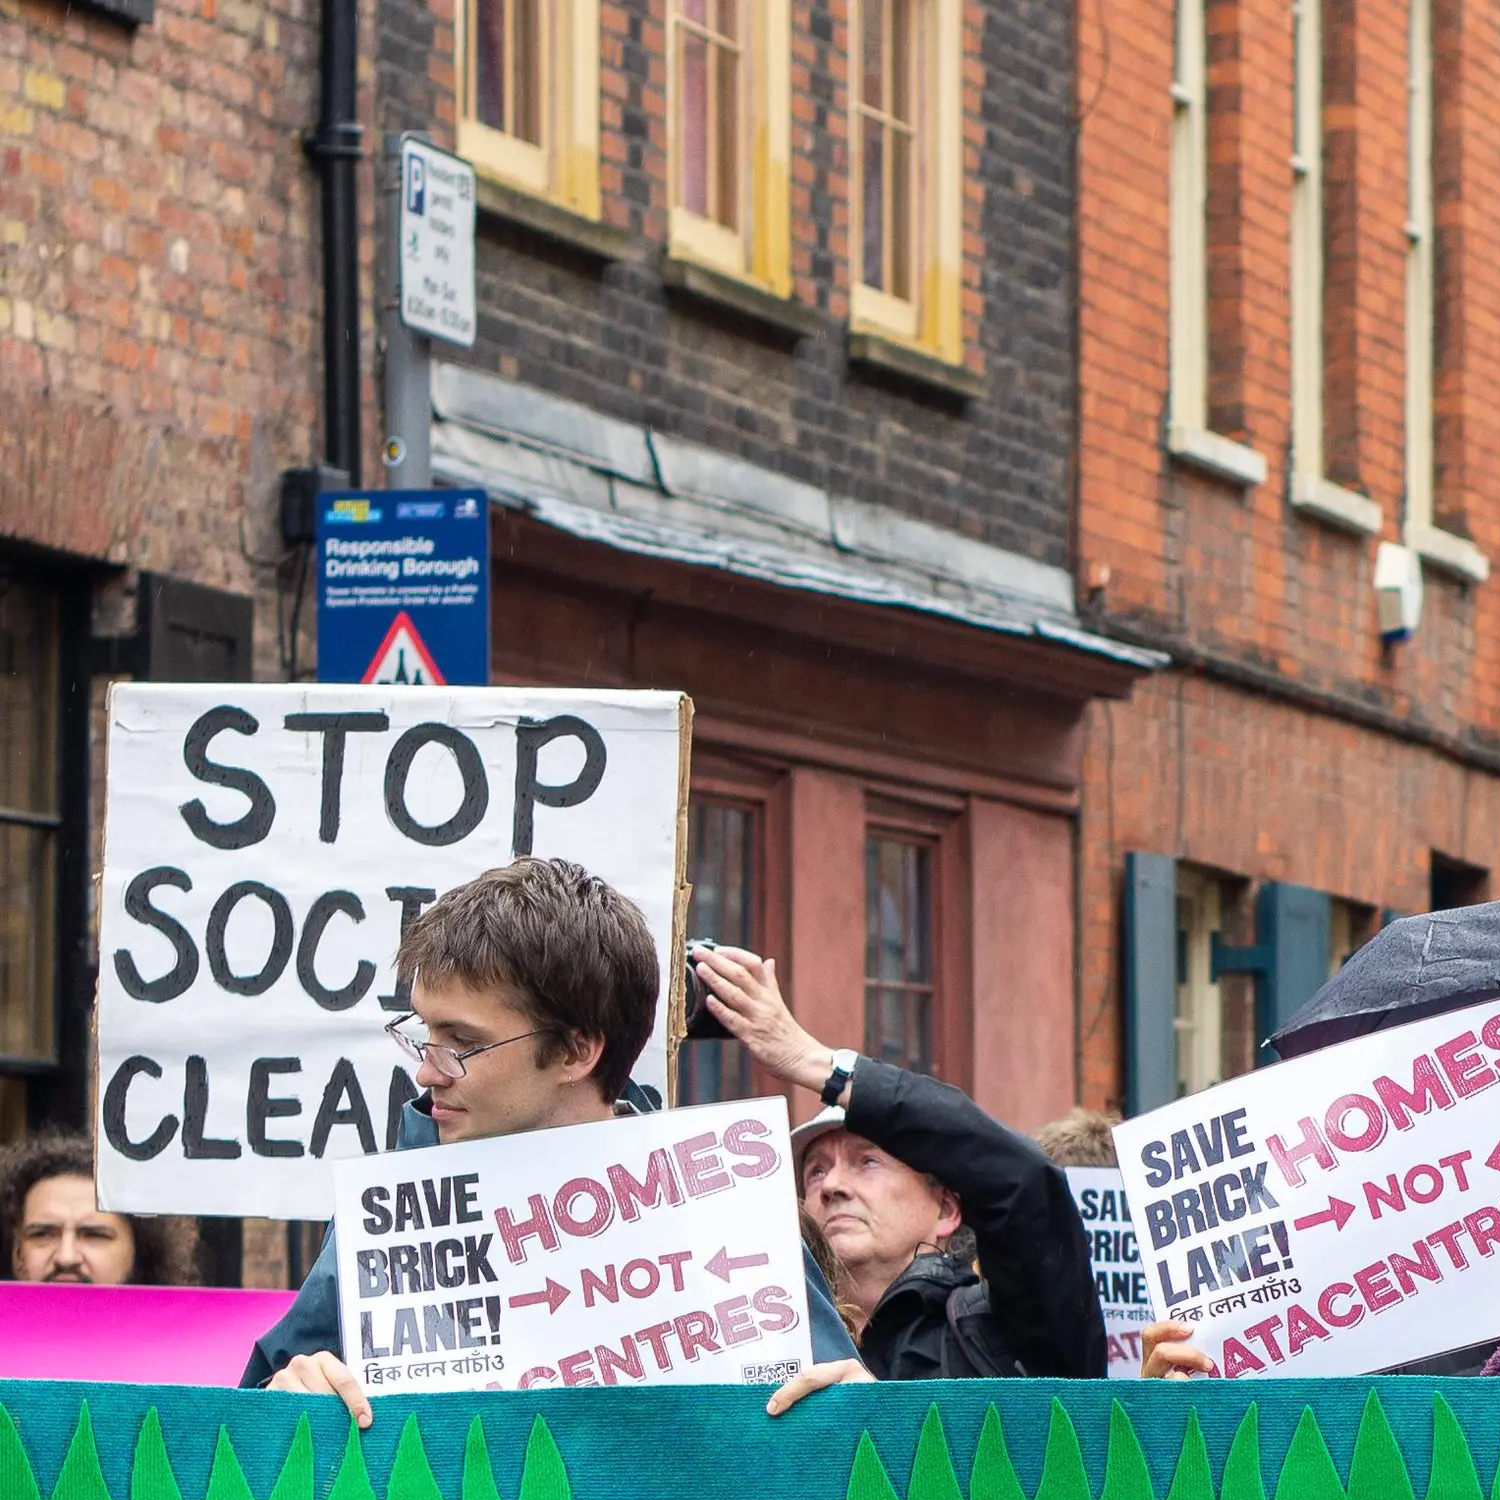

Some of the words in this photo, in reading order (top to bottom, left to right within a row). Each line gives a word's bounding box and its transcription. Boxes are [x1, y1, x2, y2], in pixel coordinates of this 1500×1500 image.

[410, 159, 423, 209] P
[326, 537, 435, 558] Responsible
[326, 559, 399, 580] Drinking
[403, 557, 479, 578] Borough
[178, 705, 607, 856] STOP
[113, 866, 436, 1011] SOCI
[103, 1055, 418, 1160] CLEA
[1141, 1108, 1255, 1189] SAVE
[361, 1173, 483, 1235] SAVE
[495, 1118, 782, 1265] HOMES
[1081, 1188, 1132, 1222] SAV
[1145, 1162, 1279, 1251] BRICK
[1362, 1149, 1472, 1220] NOT
[357, 1233, 498, 1299] BRICK
[581, 1251, 692, 1307] NOT
[1095, 1271, 1148, 1304] ANE
[1156, 1219, 1293, 1309] LANE!
[361, 1296, 501, 1360] LANE!
[407, 1361, 447, 1378] লেন
